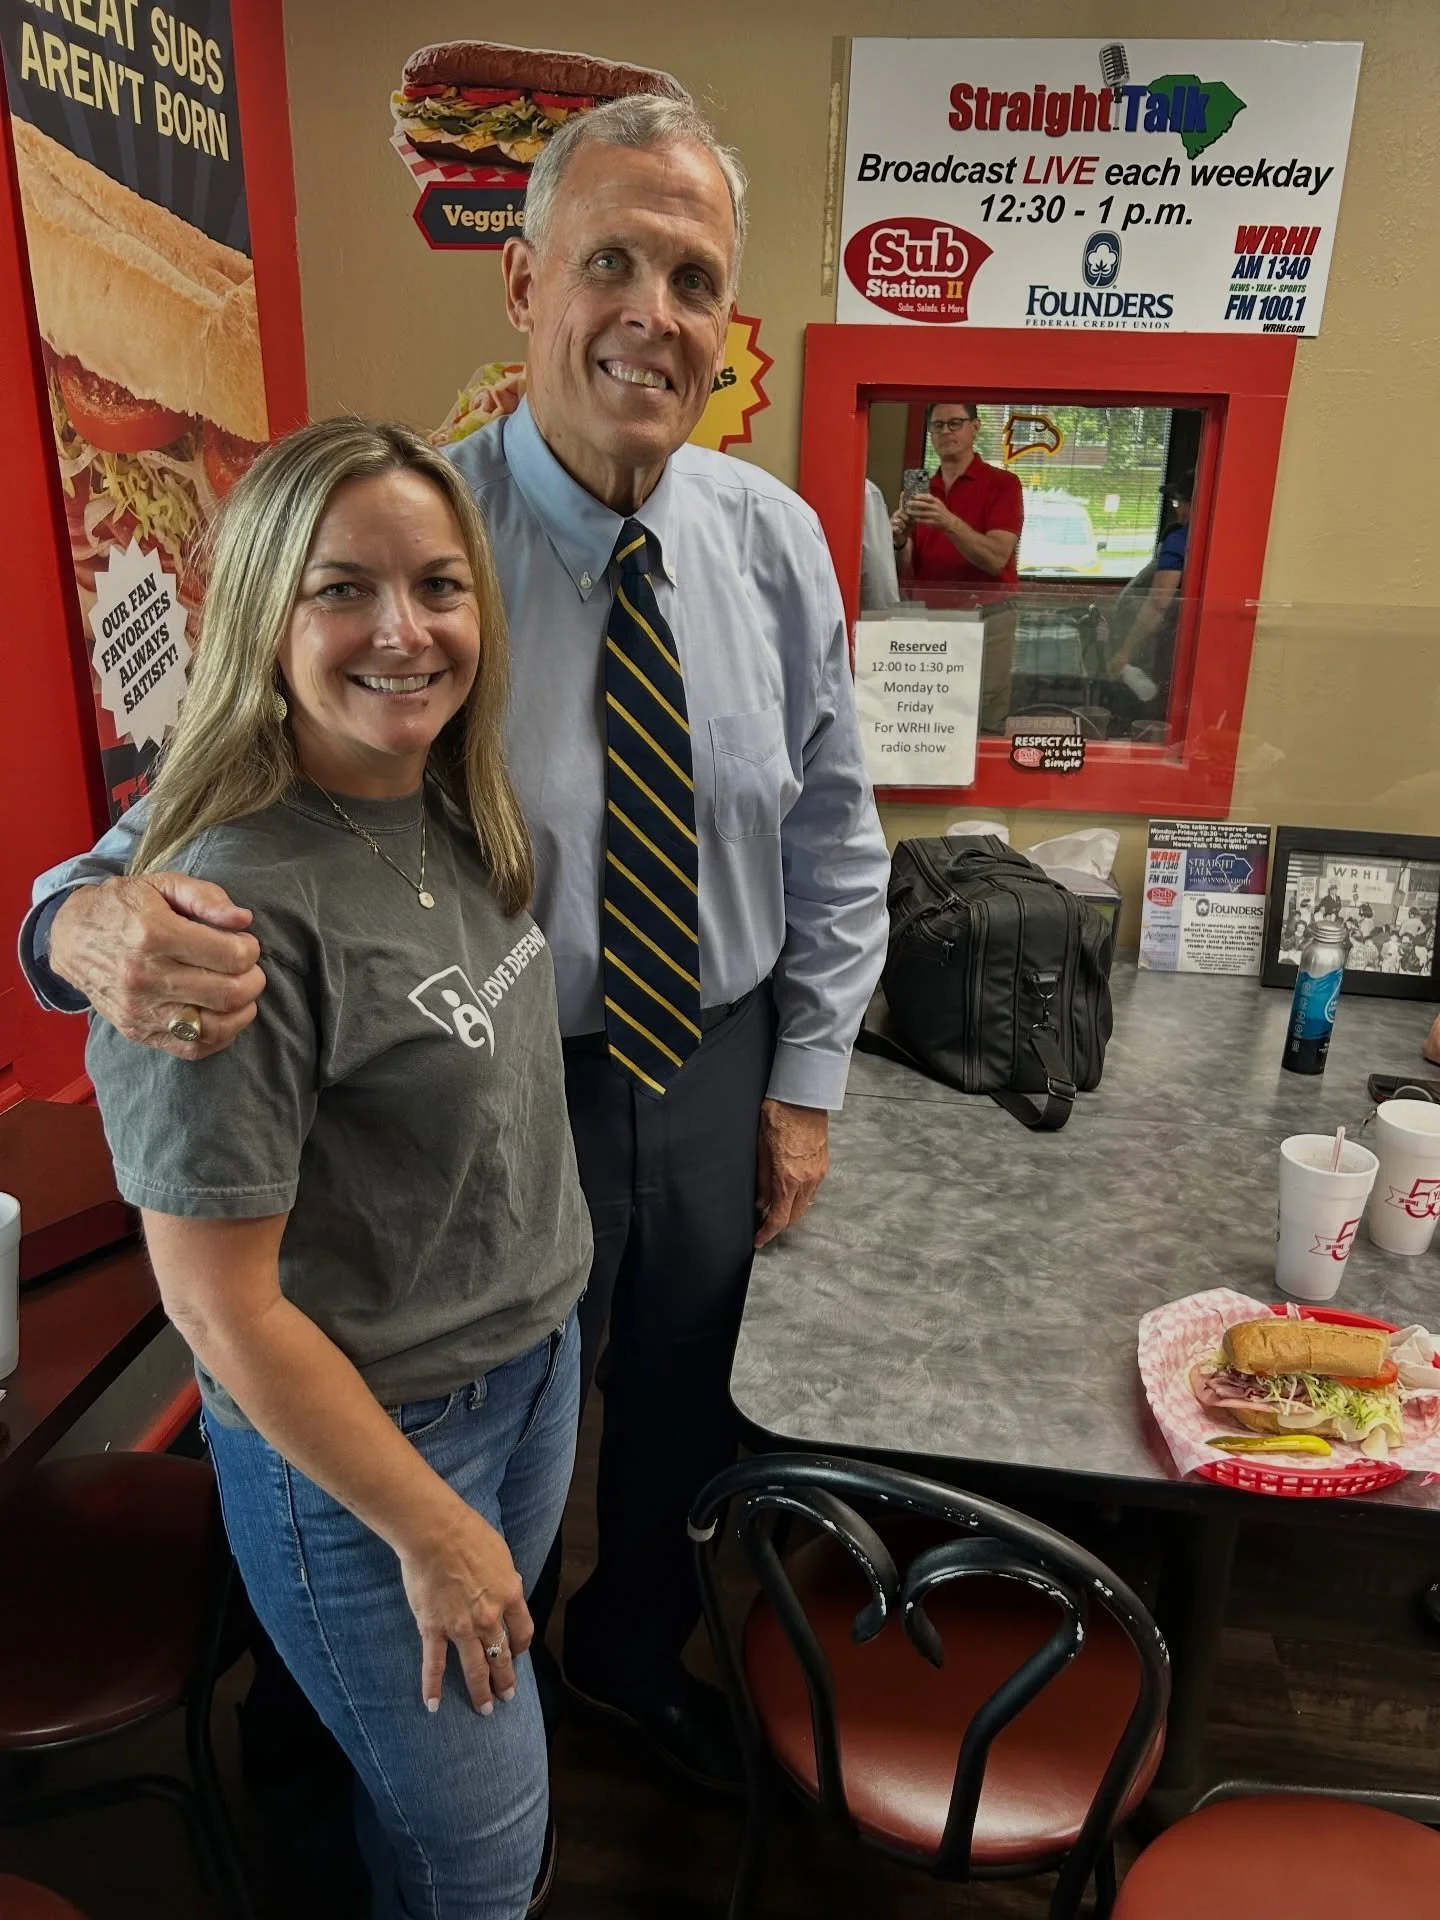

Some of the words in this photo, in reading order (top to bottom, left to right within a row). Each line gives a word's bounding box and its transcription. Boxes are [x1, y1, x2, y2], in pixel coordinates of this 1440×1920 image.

[151, 7, 224, 95] SUBS
[21, 21, 145, 124] AREN'T
[154, 81, 229, 161] BORN
[948, 83, 1114, 137] Straight
[1122, 85, 1210, 133] Talk
[857, 154, 1017, 184] Broadcast
[1023, 156, 1099, 184] LIVE
[1105, 158, 1180, 186] each
[1191, 158, 1334, 195] weekday
[442, 203, 526, 232] Veggie
[980, 194, 1065, 223] 12:30
[1098, 196, 1114, 223] 1
[1121, 202, 1192, 230] p.m.
[1234, 225, 1322, 255] WRHI
[869, 229, 967, 276] Sub
[1231, 255, 1264, 279] AM
[1267, 256, 1311, 280] 1340
[866, 279, 941, 298] Station
[946, 281, 963, 298] II
[1229, 283, 1250, 292] NEWS
[1255, 284, 1273, 292] TALK
[1278, 285, 1306, 293] SPORTS
[947, 304, 965, 313] More
[1026, 285, 1174, 319] FOUNDERS
[1224, 295, 1257, 320] FM
[1258, 296, 1306, 321] 100.1
[1025, 319, 1078, 327] FEDERAL
[1083, 320, 1128, 328] CREDIT
[1133, 321, 1171, 329] UNION
[1262, 323, 1306, 333] WRHI.com
[102, 600, 130, 639] OUR
[130, 573, 158, 613] FAN
[101, 590, 172, 673] FAVORITES
[119, 621, 171, 689] ALWAYS
[889, 641, 948, 653] Reserved
[123, 643, 180, 715] SATISFY!
[872, 662, 902, 672] 12:00
[905, 663, 916, 672] to
[919, 662, 943, 672] 1:30
[946, 664, 964, 674] pm
[884, 682, 933, 695] Monday
[937, 683, 949, 693] to
[897, 702, 934, 714] Friday
[874, 722, 894, 733] For
[897, 723, 930, 733] WRHI
[934, 722, 955, 733] live
[881, 742, 911, 752] radio
[914, 742, 946, 752] show
[1014, 736, 1061, 746] RESPECT
[1062, 737, 1083, 747] ALL
[1062, 748, 1081, 757] that
[1150, 861, 1161, 869] AM
[1162, 862, 1179, 870] 1340
[1148, 874, 1160, 884] FM
[1210, 903, 1264, 917] FOUNDERS
[478, 963, 516, 1008] LOVE
